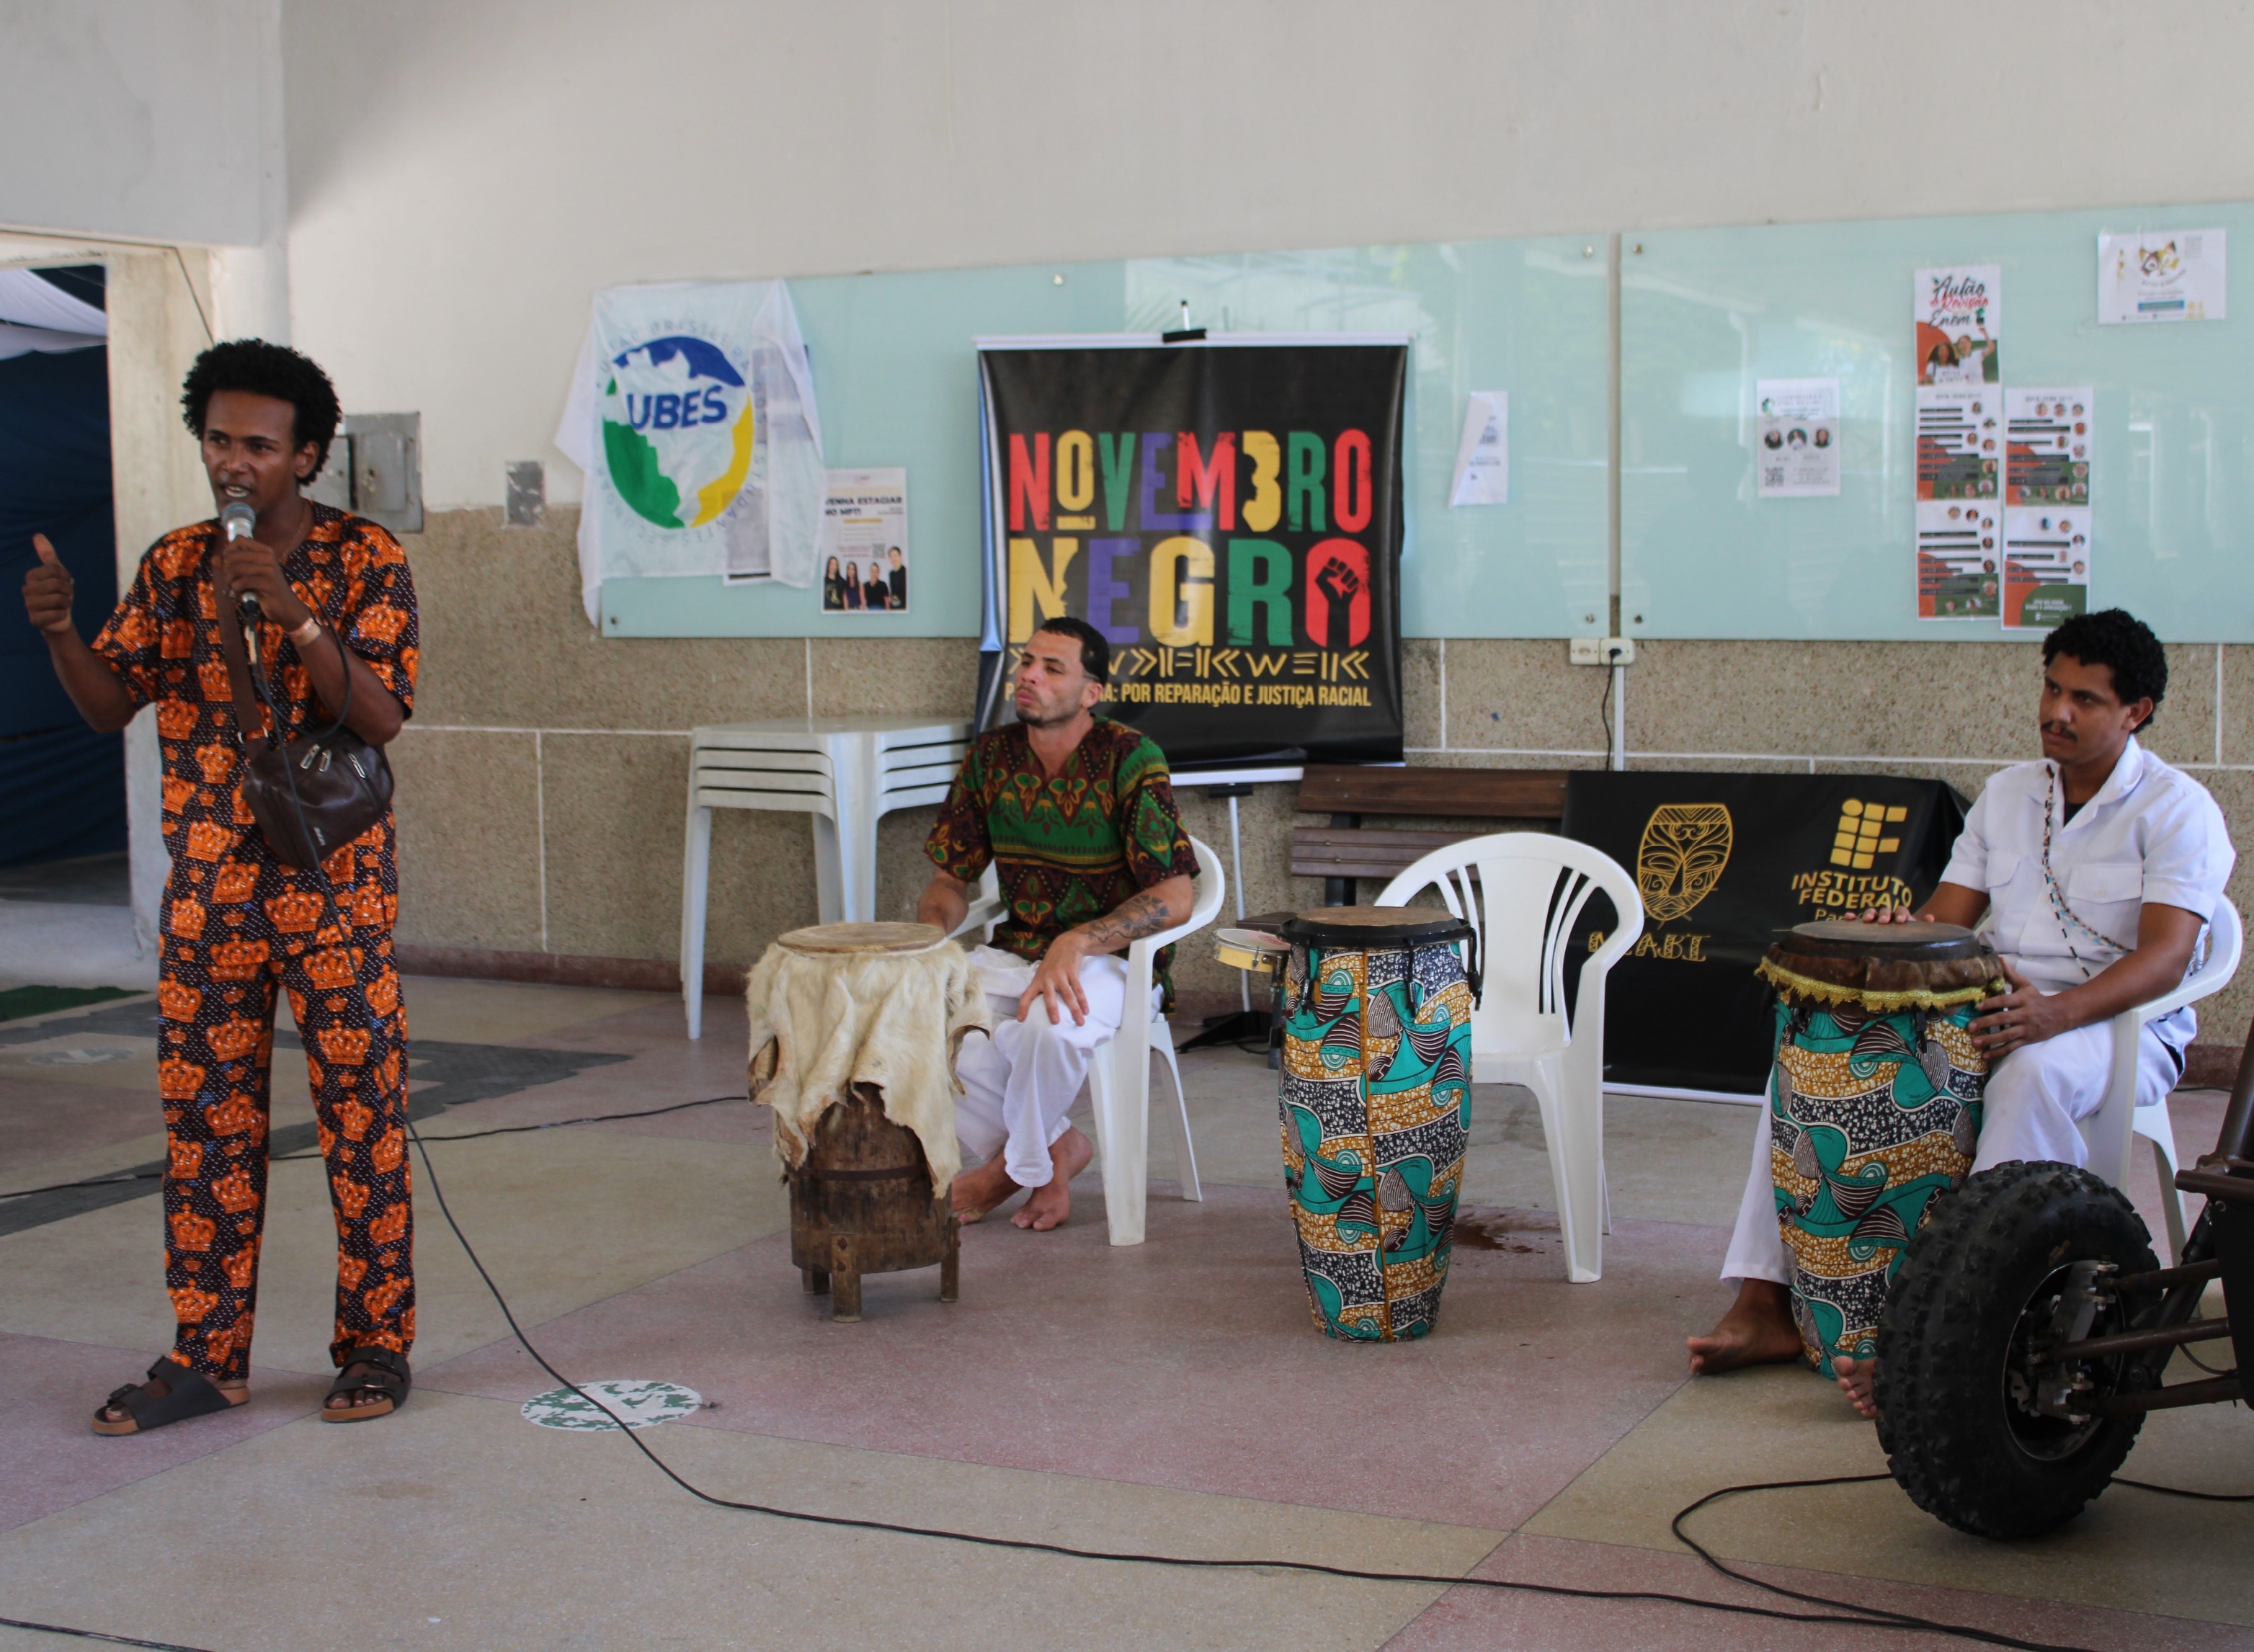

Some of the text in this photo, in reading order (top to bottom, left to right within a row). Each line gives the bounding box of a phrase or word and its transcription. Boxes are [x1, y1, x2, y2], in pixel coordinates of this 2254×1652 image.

[626, 385, 726, 430] UBES
[1009, 429, 1373, 532] NOVEMBRO
[1008, 536, 1371, 647] NEGRO
[1121, 683, 1151, 703] POR
[1154, 680, 1241, 707] REPARAÇÃO
[1244, 685, 1255, 705] E
[1256, 685, 1315, 708] JUSTIÇA
[1318, 686, 1372, 706] RACIAL
[1791, 870, 1912, 908] INSTITUTO
[1587, 931, 1711, 963] NABI
